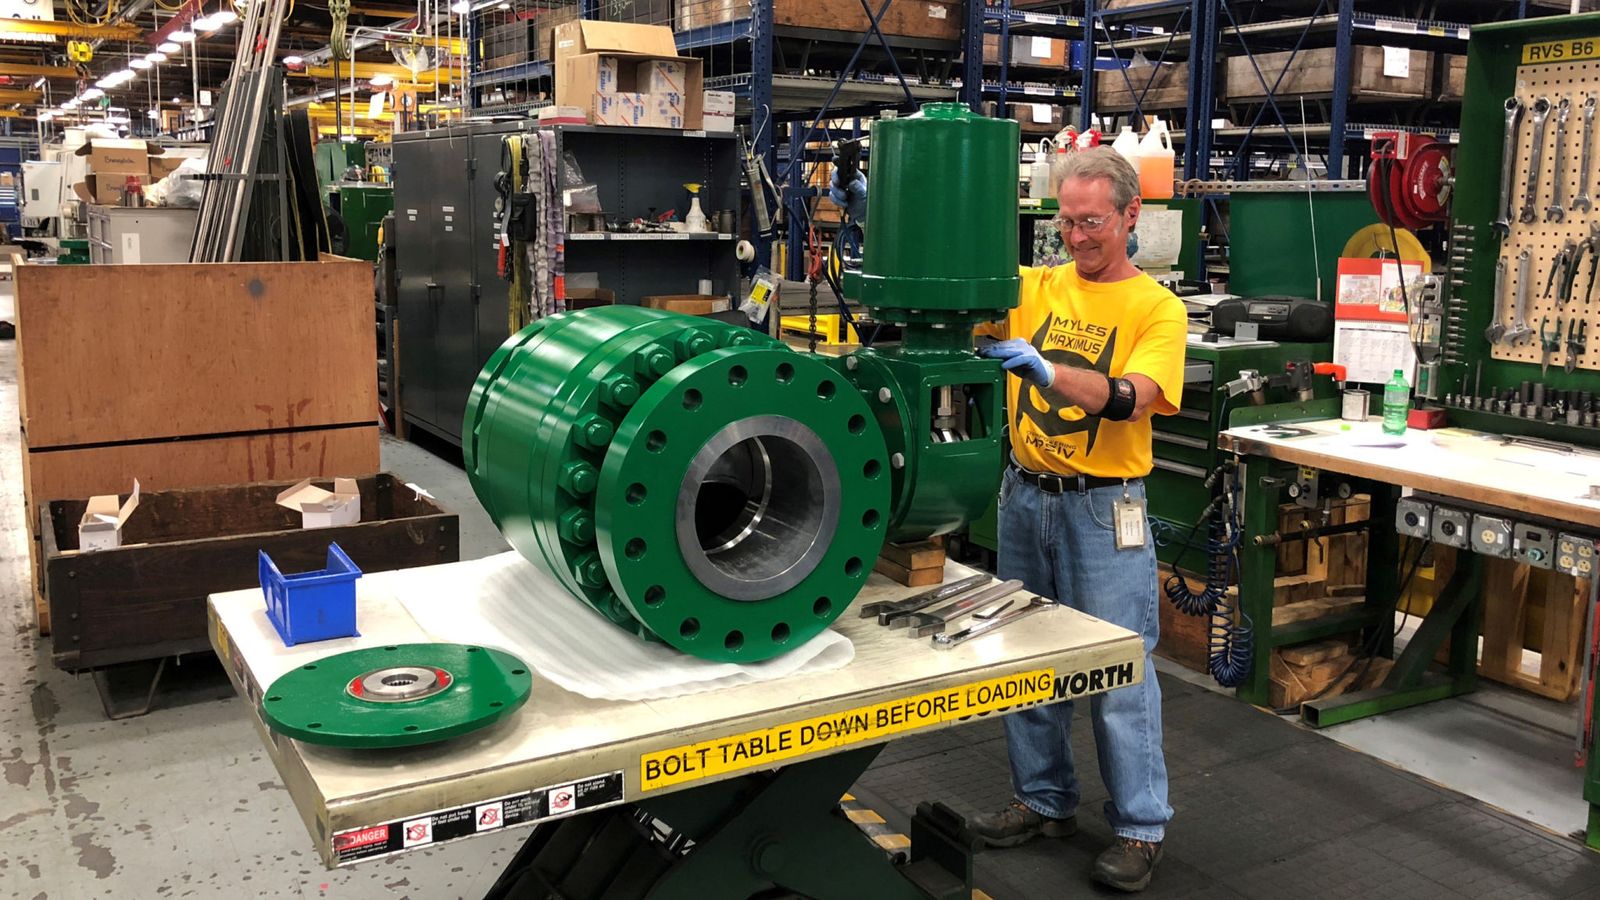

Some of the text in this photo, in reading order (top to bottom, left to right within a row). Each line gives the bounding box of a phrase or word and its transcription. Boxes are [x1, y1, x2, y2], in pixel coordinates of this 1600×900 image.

[1530, 41, 1594, 60] RVS B6
[1053, 316, 1107, 337] MYLES
[1047, 333, 1102, 355] MAXIMUS
[646, 673, 1051, 781] BOLT TABLE DOWN BEFORE LOADING
